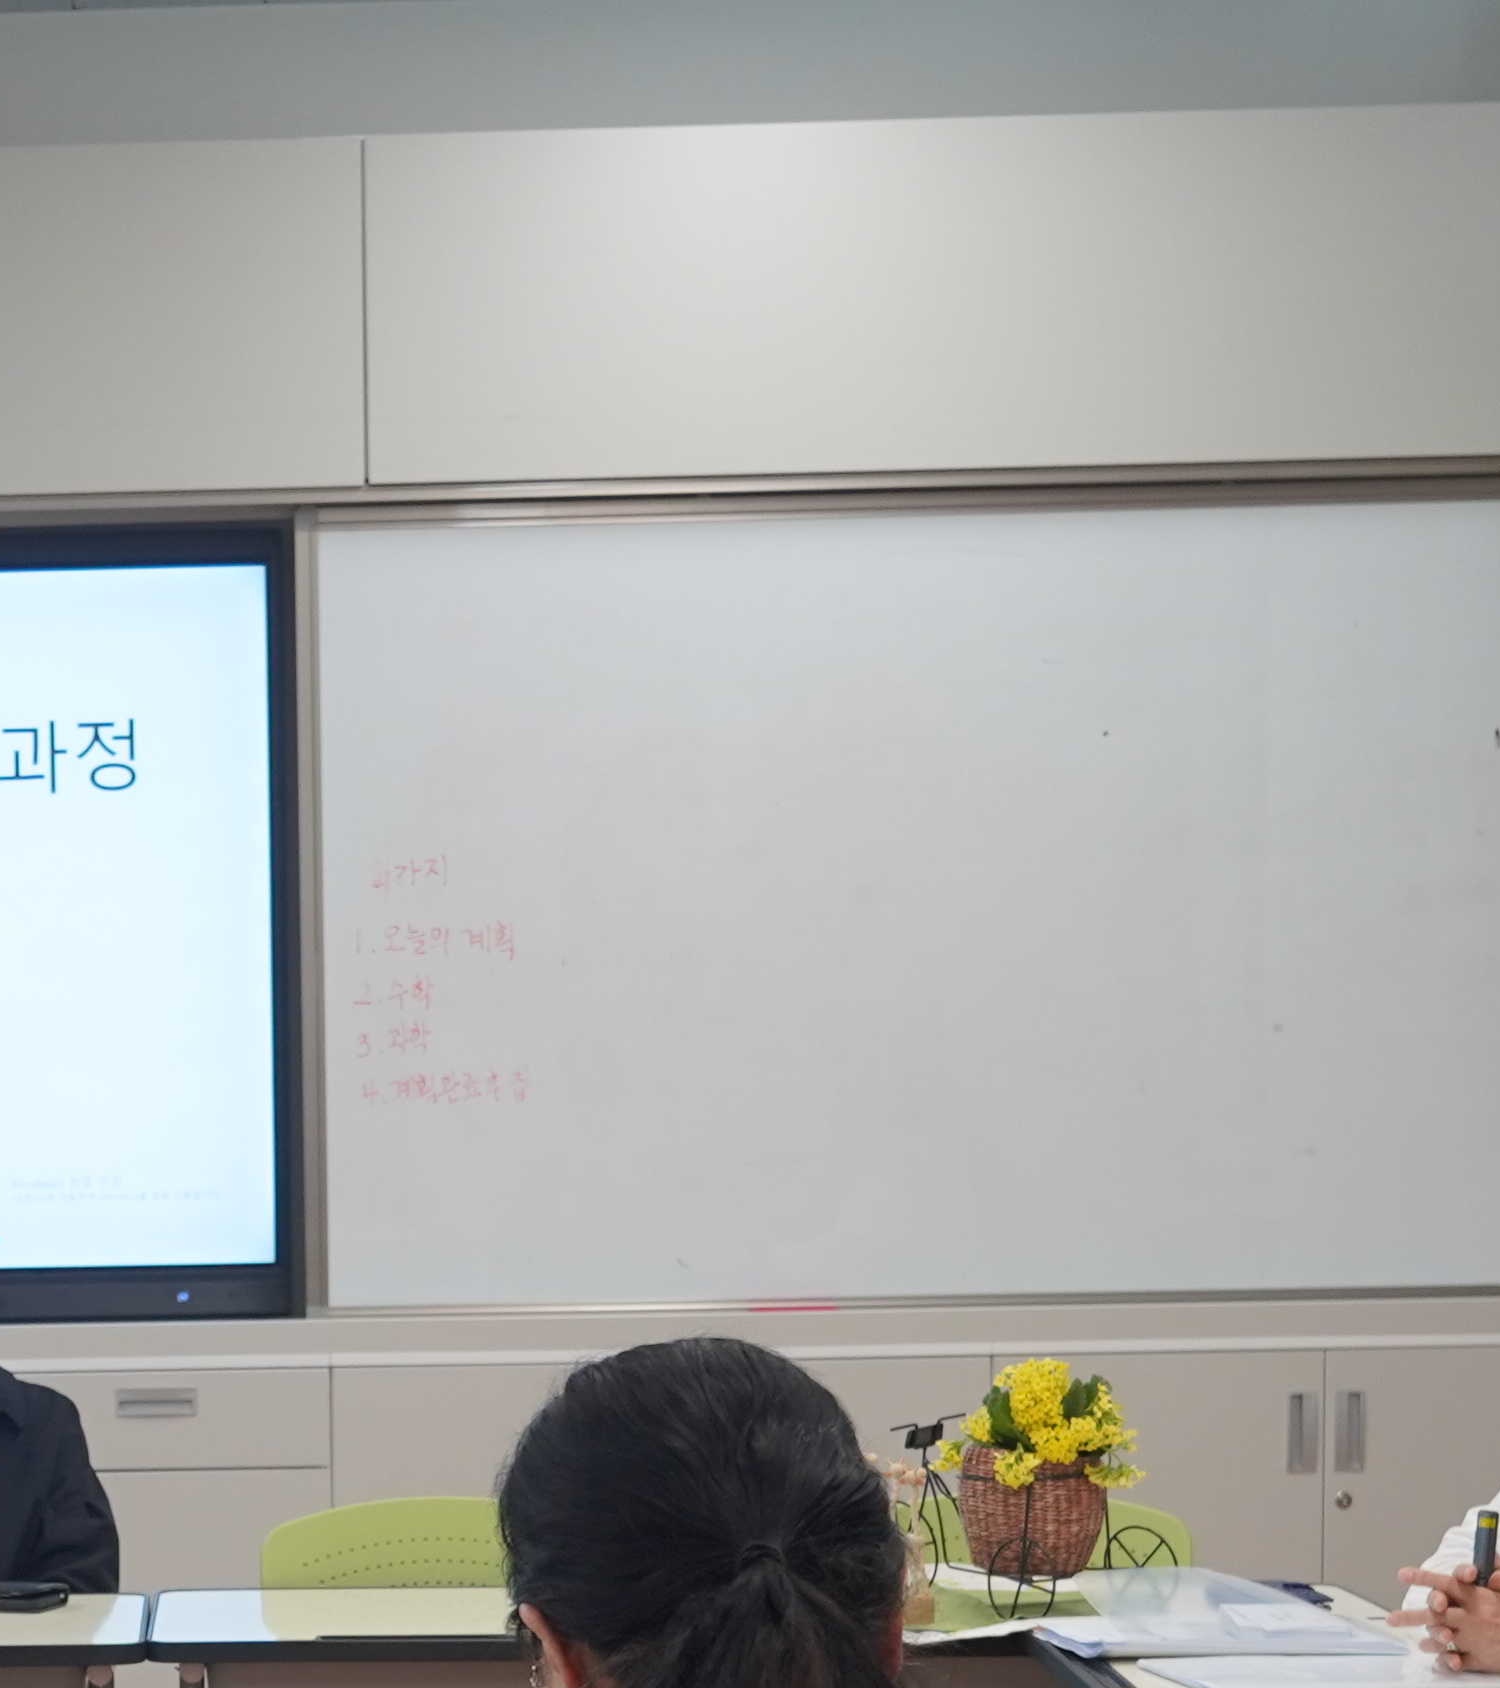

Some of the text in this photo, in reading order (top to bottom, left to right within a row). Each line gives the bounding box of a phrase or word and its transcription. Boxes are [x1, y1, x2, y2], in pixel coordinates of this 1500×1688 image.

[384, 923, 450, 957] 오늘의
[461, 920, 517, 960] 계획
[386, 973, 436, 1010] 수학
[387, 1021, 432, 1056] 과학
